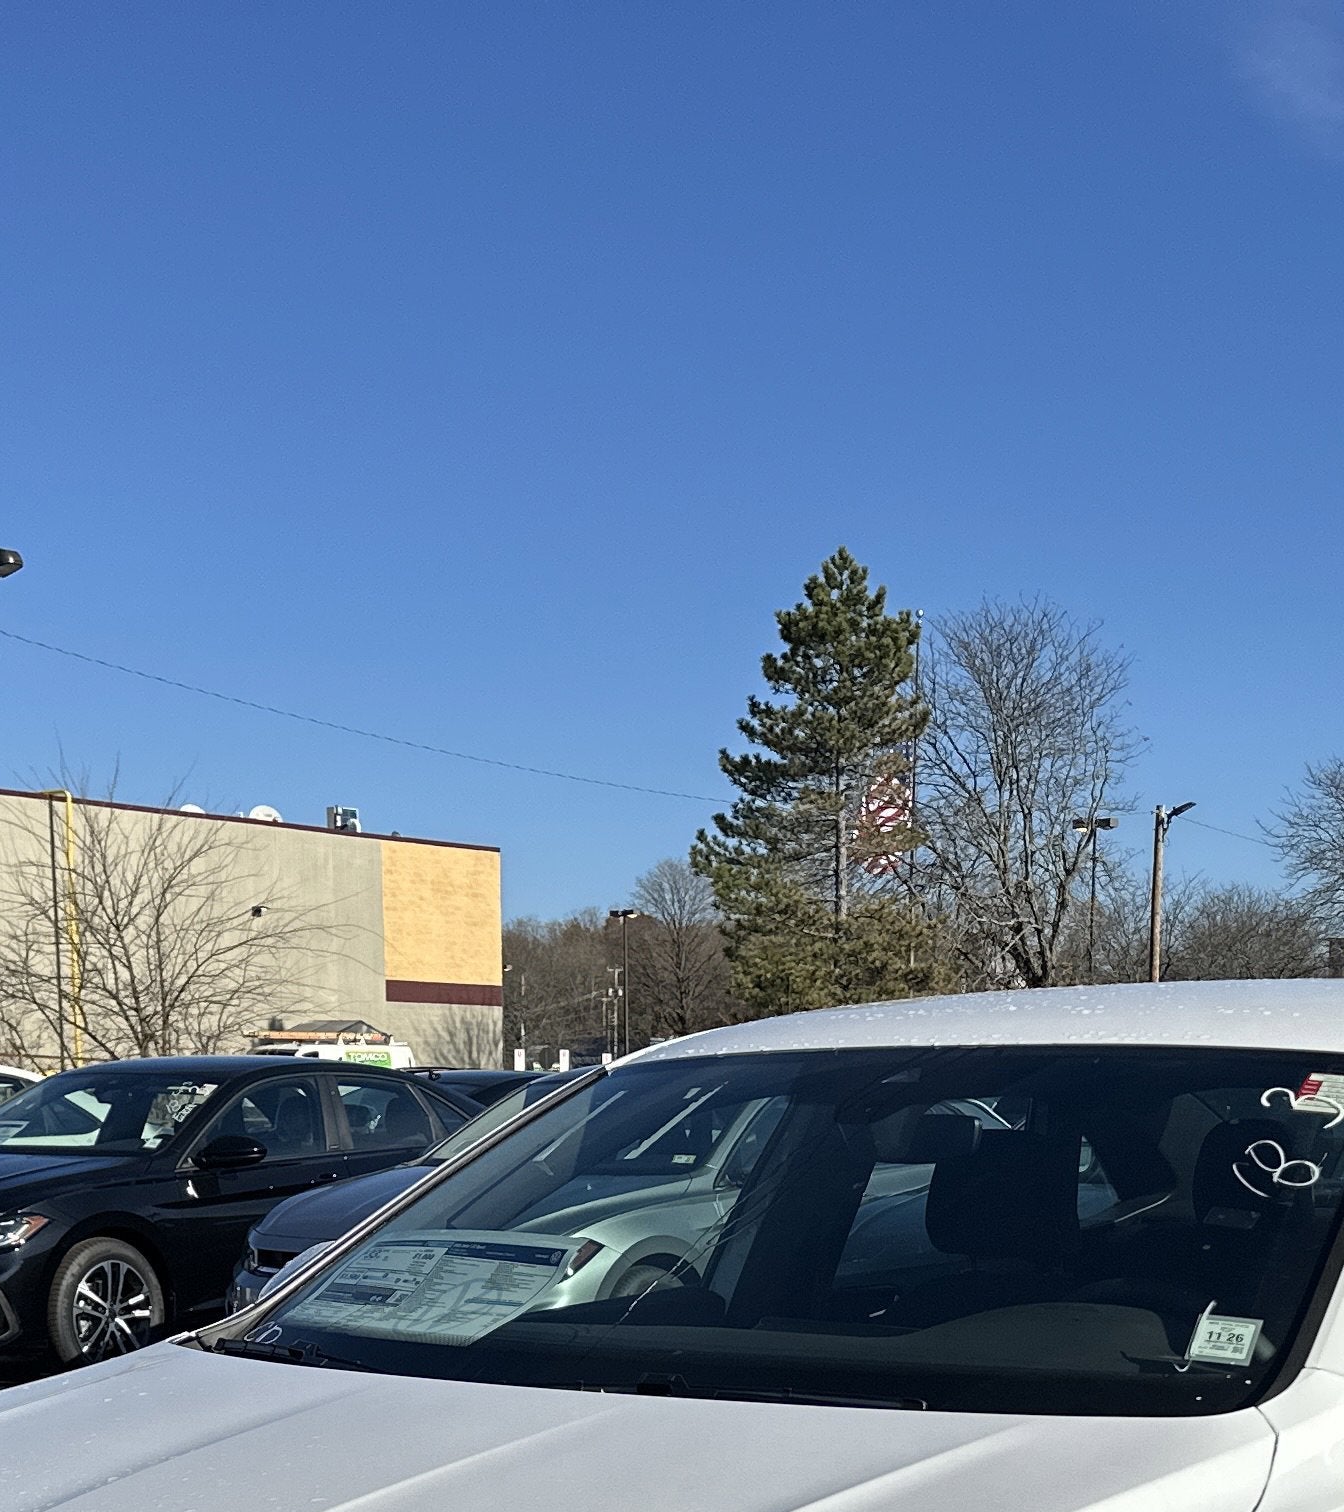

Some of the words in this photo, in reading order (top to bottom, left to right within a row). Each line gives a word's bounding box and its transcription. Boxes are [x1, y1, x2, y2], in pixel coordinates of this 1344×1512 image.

[348, 1052, 387, 1061] TOMCO
[1207, 1330, 1222, 1341] 11
[1226, 1332, 1245, 1343] 26
